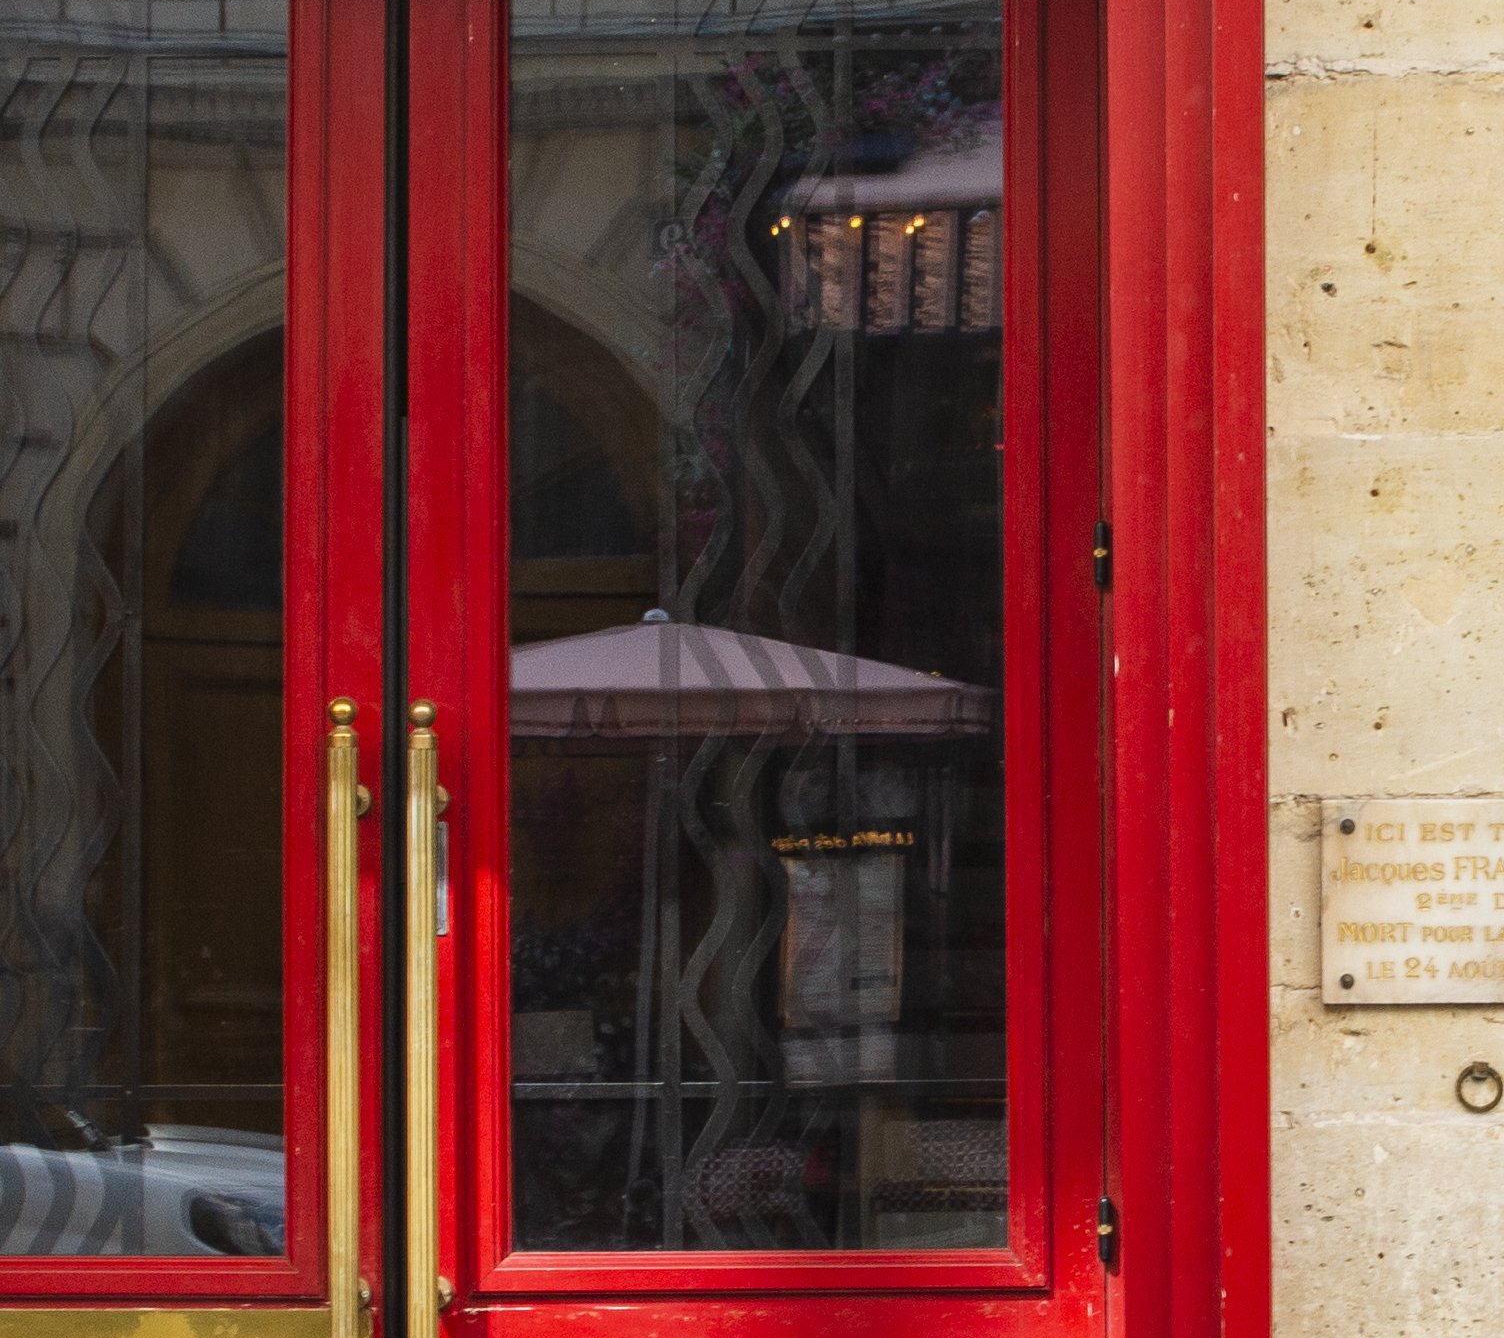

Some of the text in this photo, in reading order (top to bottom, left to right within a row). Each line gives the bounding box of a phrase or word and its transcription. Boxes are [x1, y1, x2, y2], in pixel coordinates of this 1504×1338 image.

[1364, 822, 1406, 843] ICI
[1419, 822, 1475, 843] EST
[1329, 857, 1445, 885] Jacques
[1337, 921, 1413, 943] MORT
[1422, 925, 1473, 943] POUR
[1365, 960, 1395, 981] LE
[1403, 956, 1439, 980] 24
